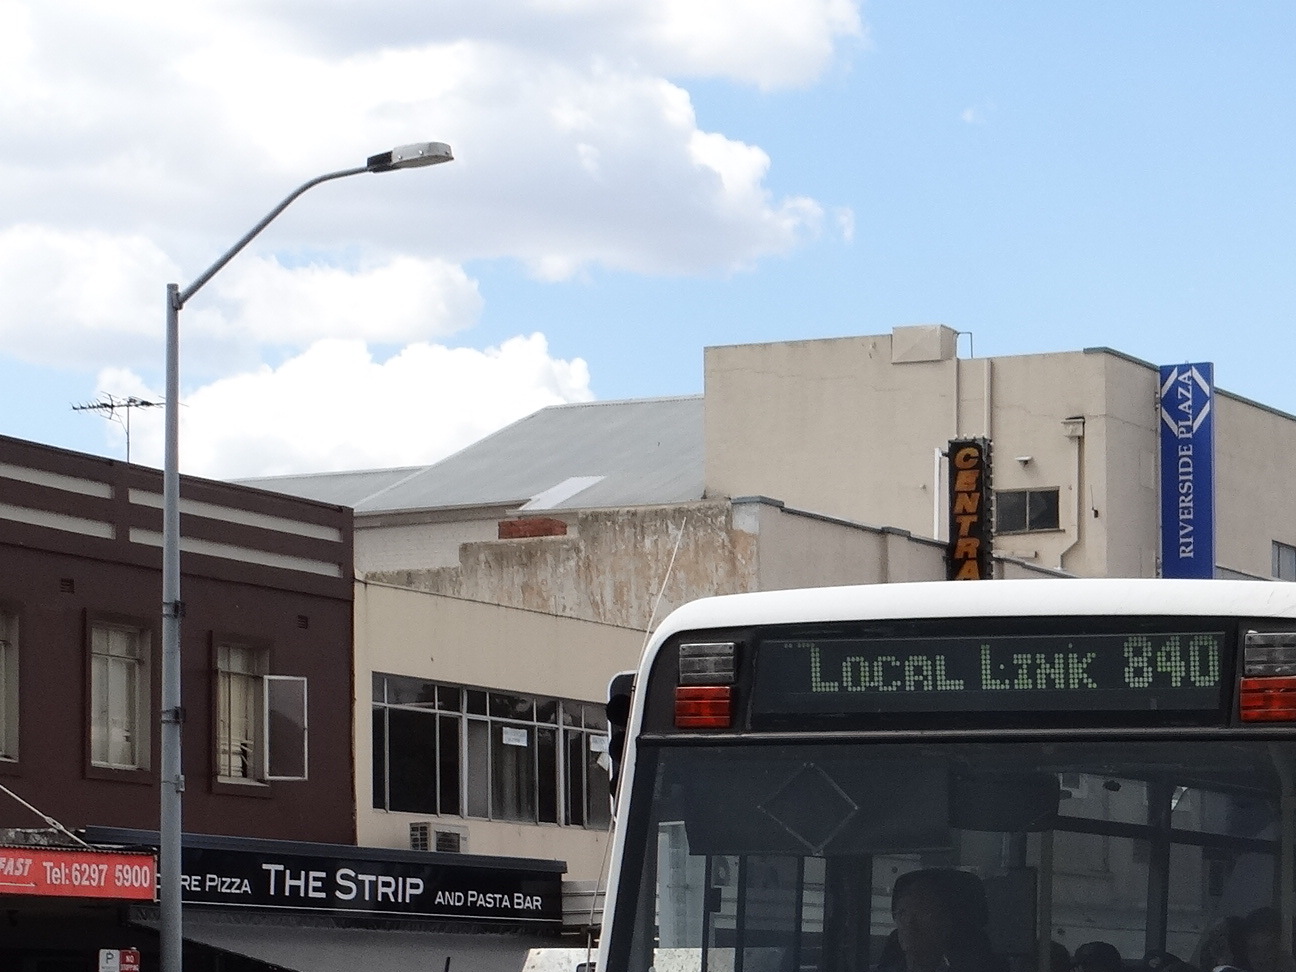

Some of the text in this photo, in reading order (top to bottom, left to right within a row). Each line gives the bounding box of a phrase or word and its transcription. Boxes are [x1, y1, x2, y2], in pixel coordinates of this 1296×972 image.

[1177, 368, 1194, 559] RIVERSIDE PLAZA
[810, 635, 1220, 692] LOCAL LINK 840
[115, 864, 150, 888] 5900
[205, 874, 252, 894] PIZZA
[262, 863, 327, 898] THE
[334, 868, 425, 903] STRIP
[435, 890, 464, 906] AND
[467, 891, 511, 908] PASTA
[513, 893, 542, 910] BAR
